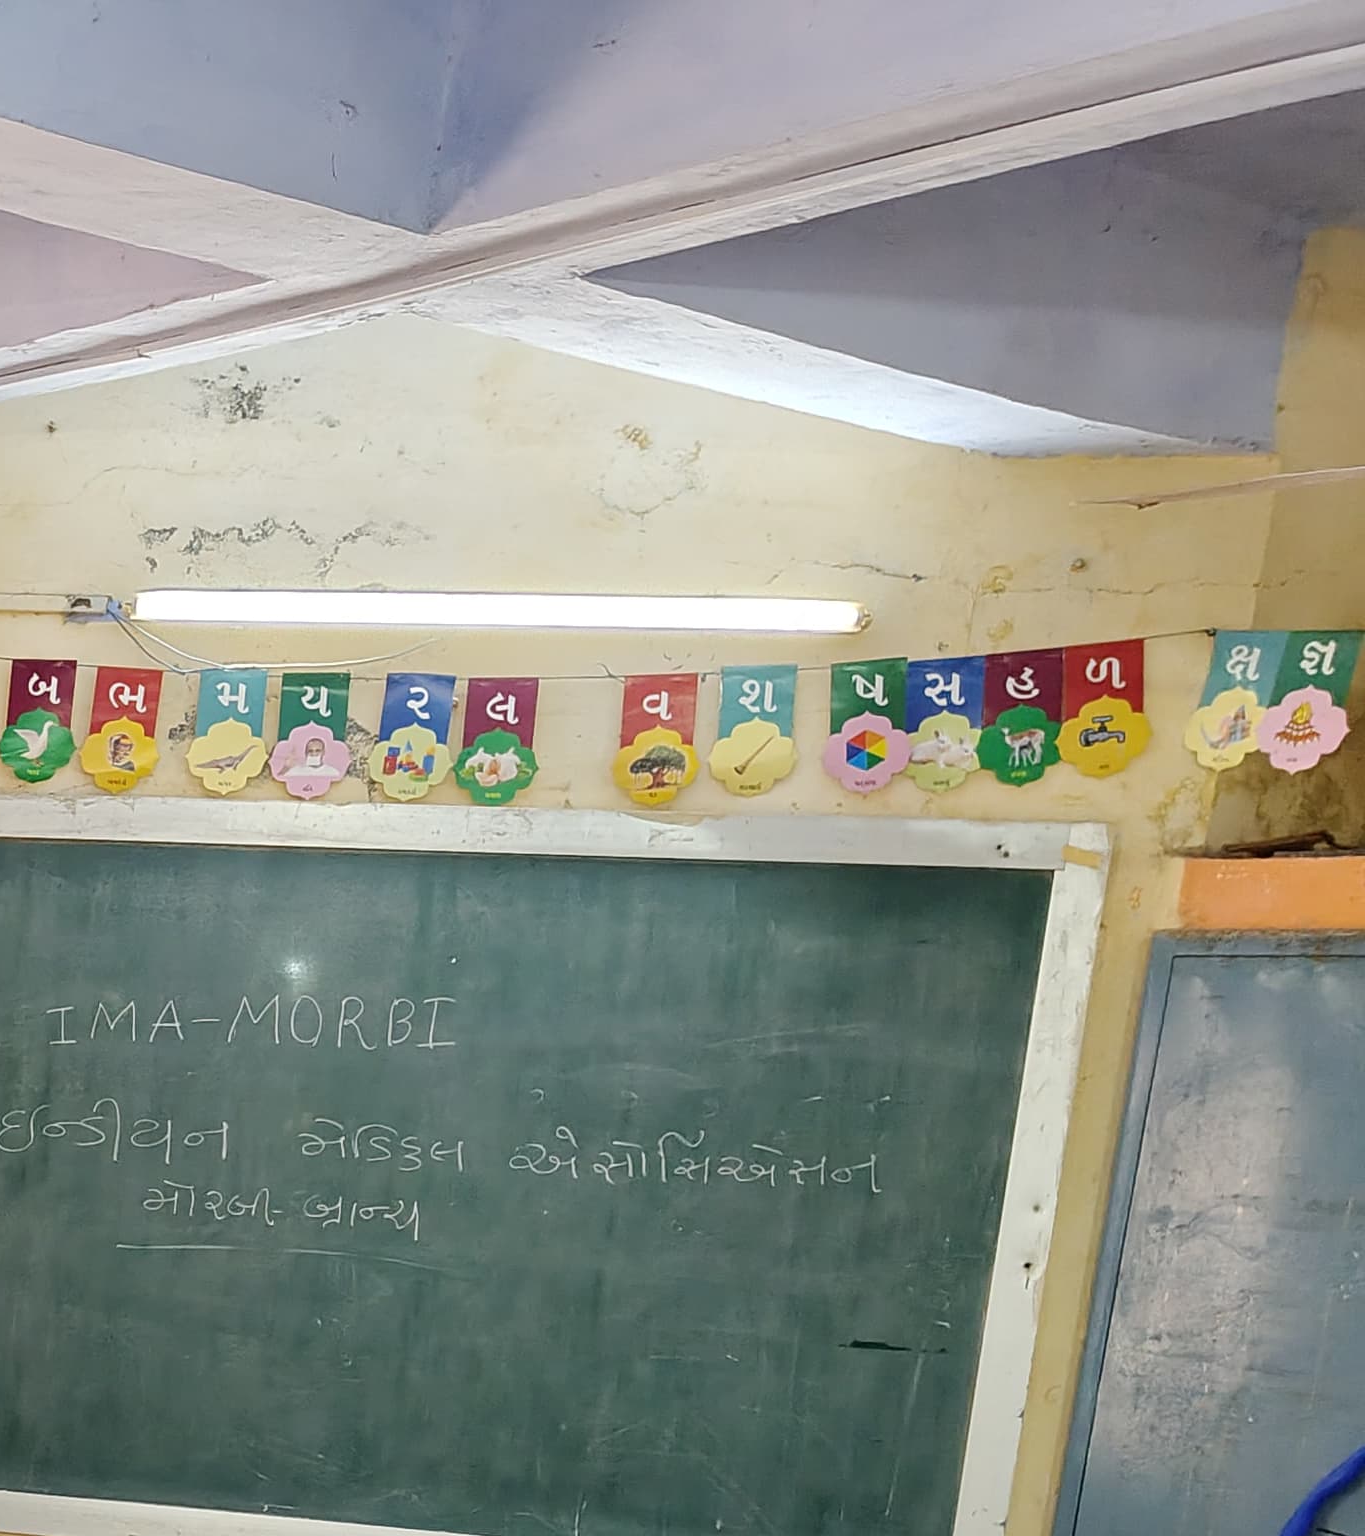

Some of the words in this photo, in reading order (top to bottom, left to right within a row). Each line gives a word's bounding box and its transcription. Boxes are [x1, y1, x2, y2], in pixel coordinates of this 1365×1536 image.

[1085, 656, 1126, 689] ળ
[1225, 644, 1262, 681] ક્ષ
[1299, 639, 1337, 676] જ્ઞ
[28, 672, 61, 705] બ
[108, 682, 147, 713] ભ
[216, 682, 249, 715] મ
[738, 679, 778, 713] શ
[852, 673, 889, 707] ષ
[924, 672, 966, 706] સ
[1005, 667, 1041, 700] હ
[300, 685, 332, 718] ય
[406, 687, 431, 720] ર
[486, 692, 519, 725] લ
[642, 691, 672, 721] વ
